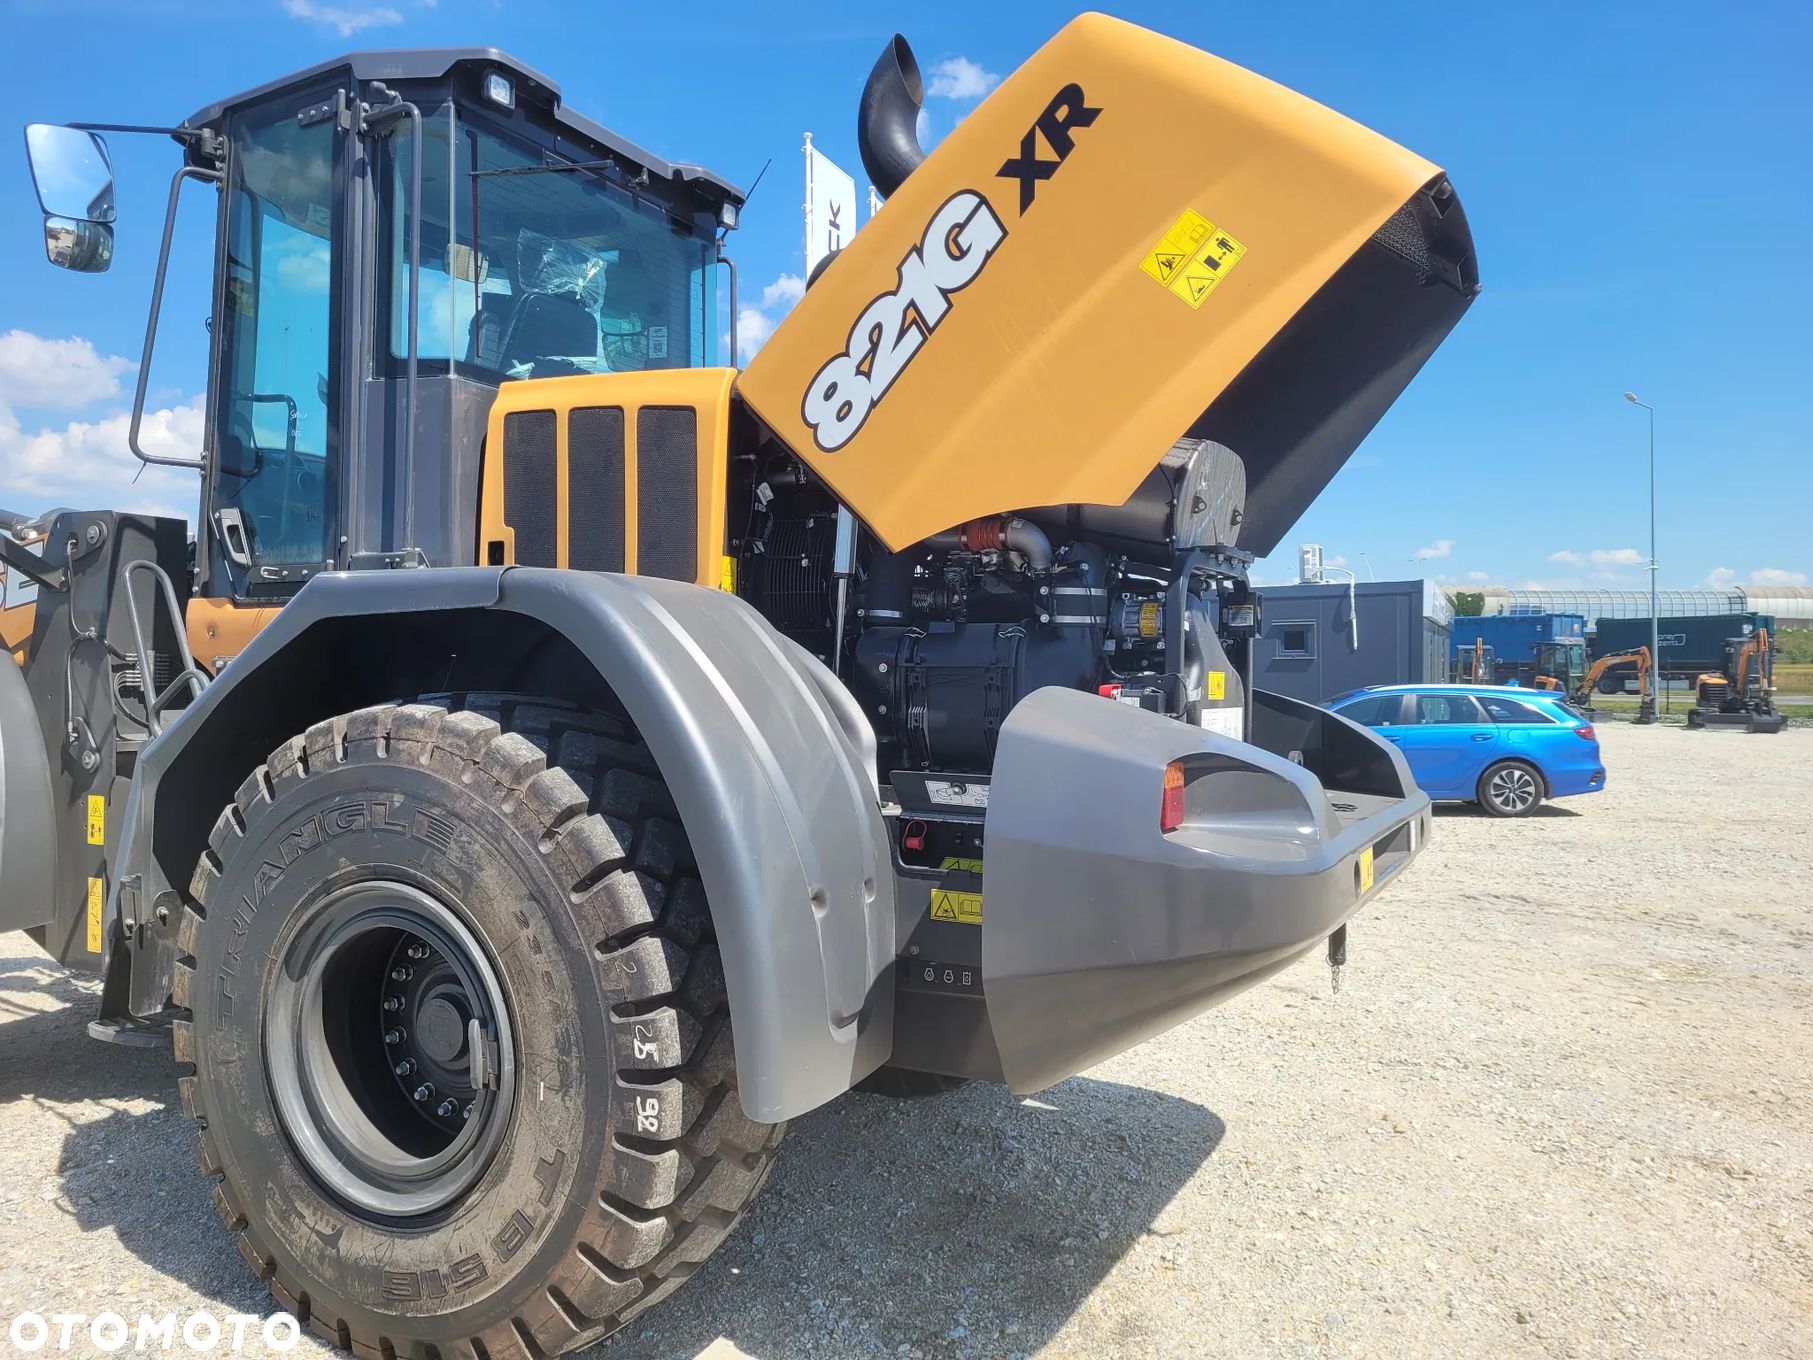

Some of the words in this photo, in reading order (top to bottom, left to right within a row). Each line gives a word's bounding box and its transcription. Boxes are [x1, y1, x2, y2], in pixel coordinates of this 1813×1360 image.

[801, 188, 1009, 453] 821G
[996, 83, 1104, 218] XR
[216, 800, 456, 1031] TRIANGLE
